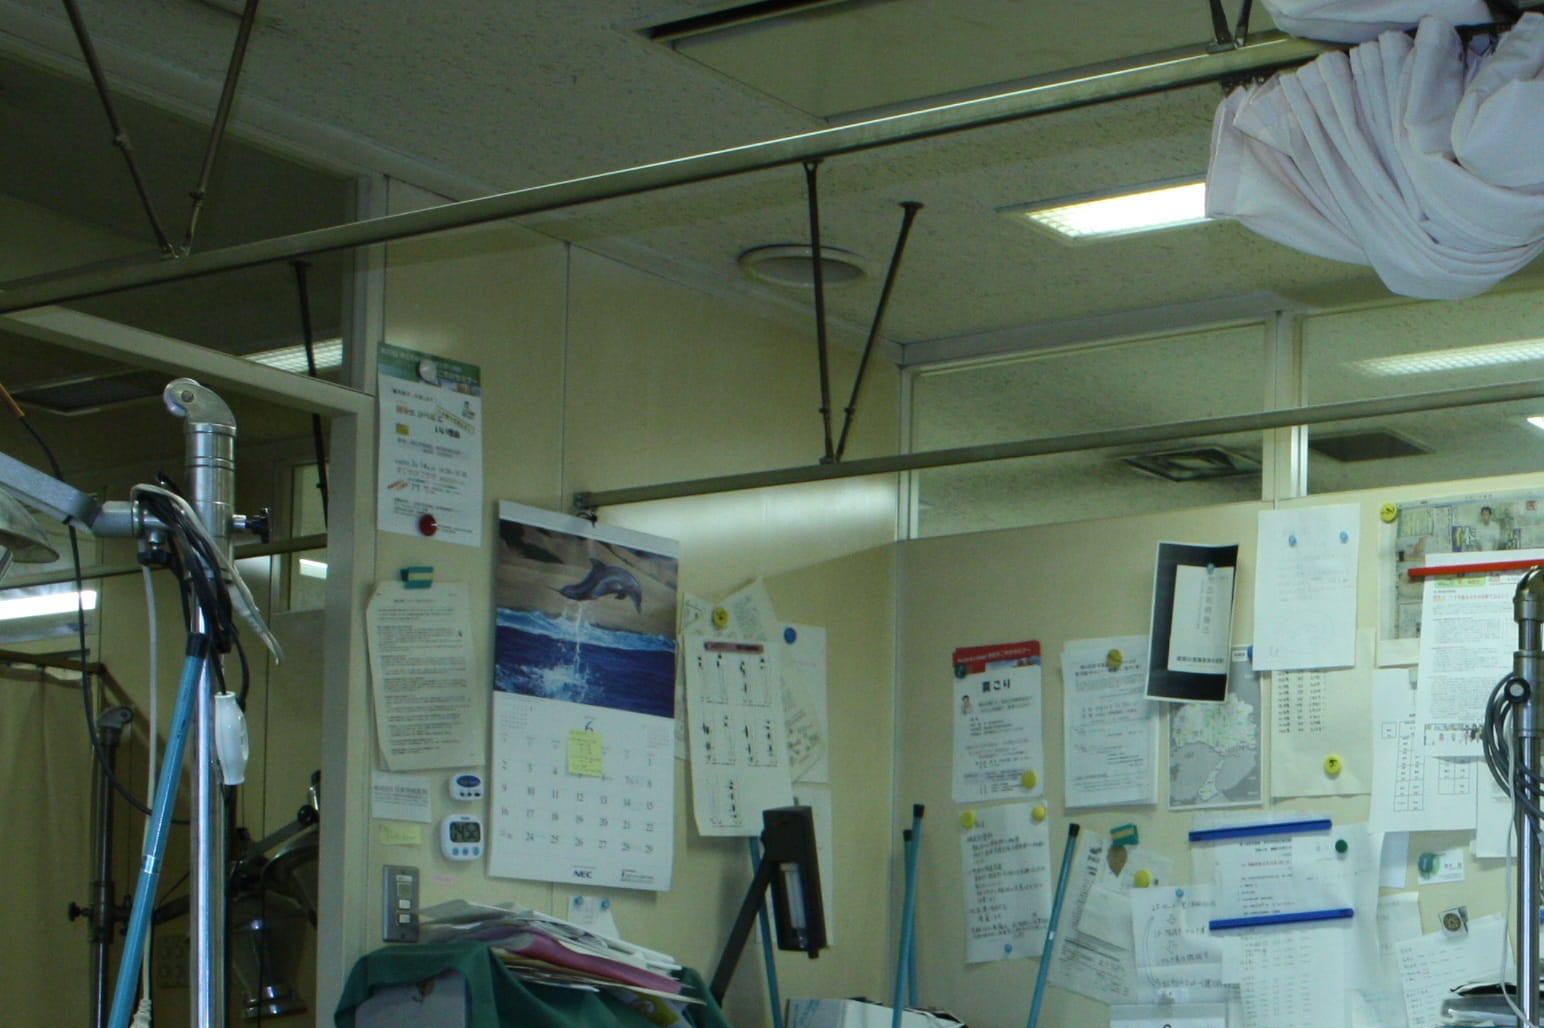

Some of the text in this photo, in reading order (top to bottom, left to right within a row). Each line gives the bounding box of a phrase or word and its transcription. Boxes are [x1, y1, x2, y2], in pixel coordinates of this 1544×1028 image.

[982, 679, 1011, 693] 肩こり
[573, 870, 593, 879] NEC
